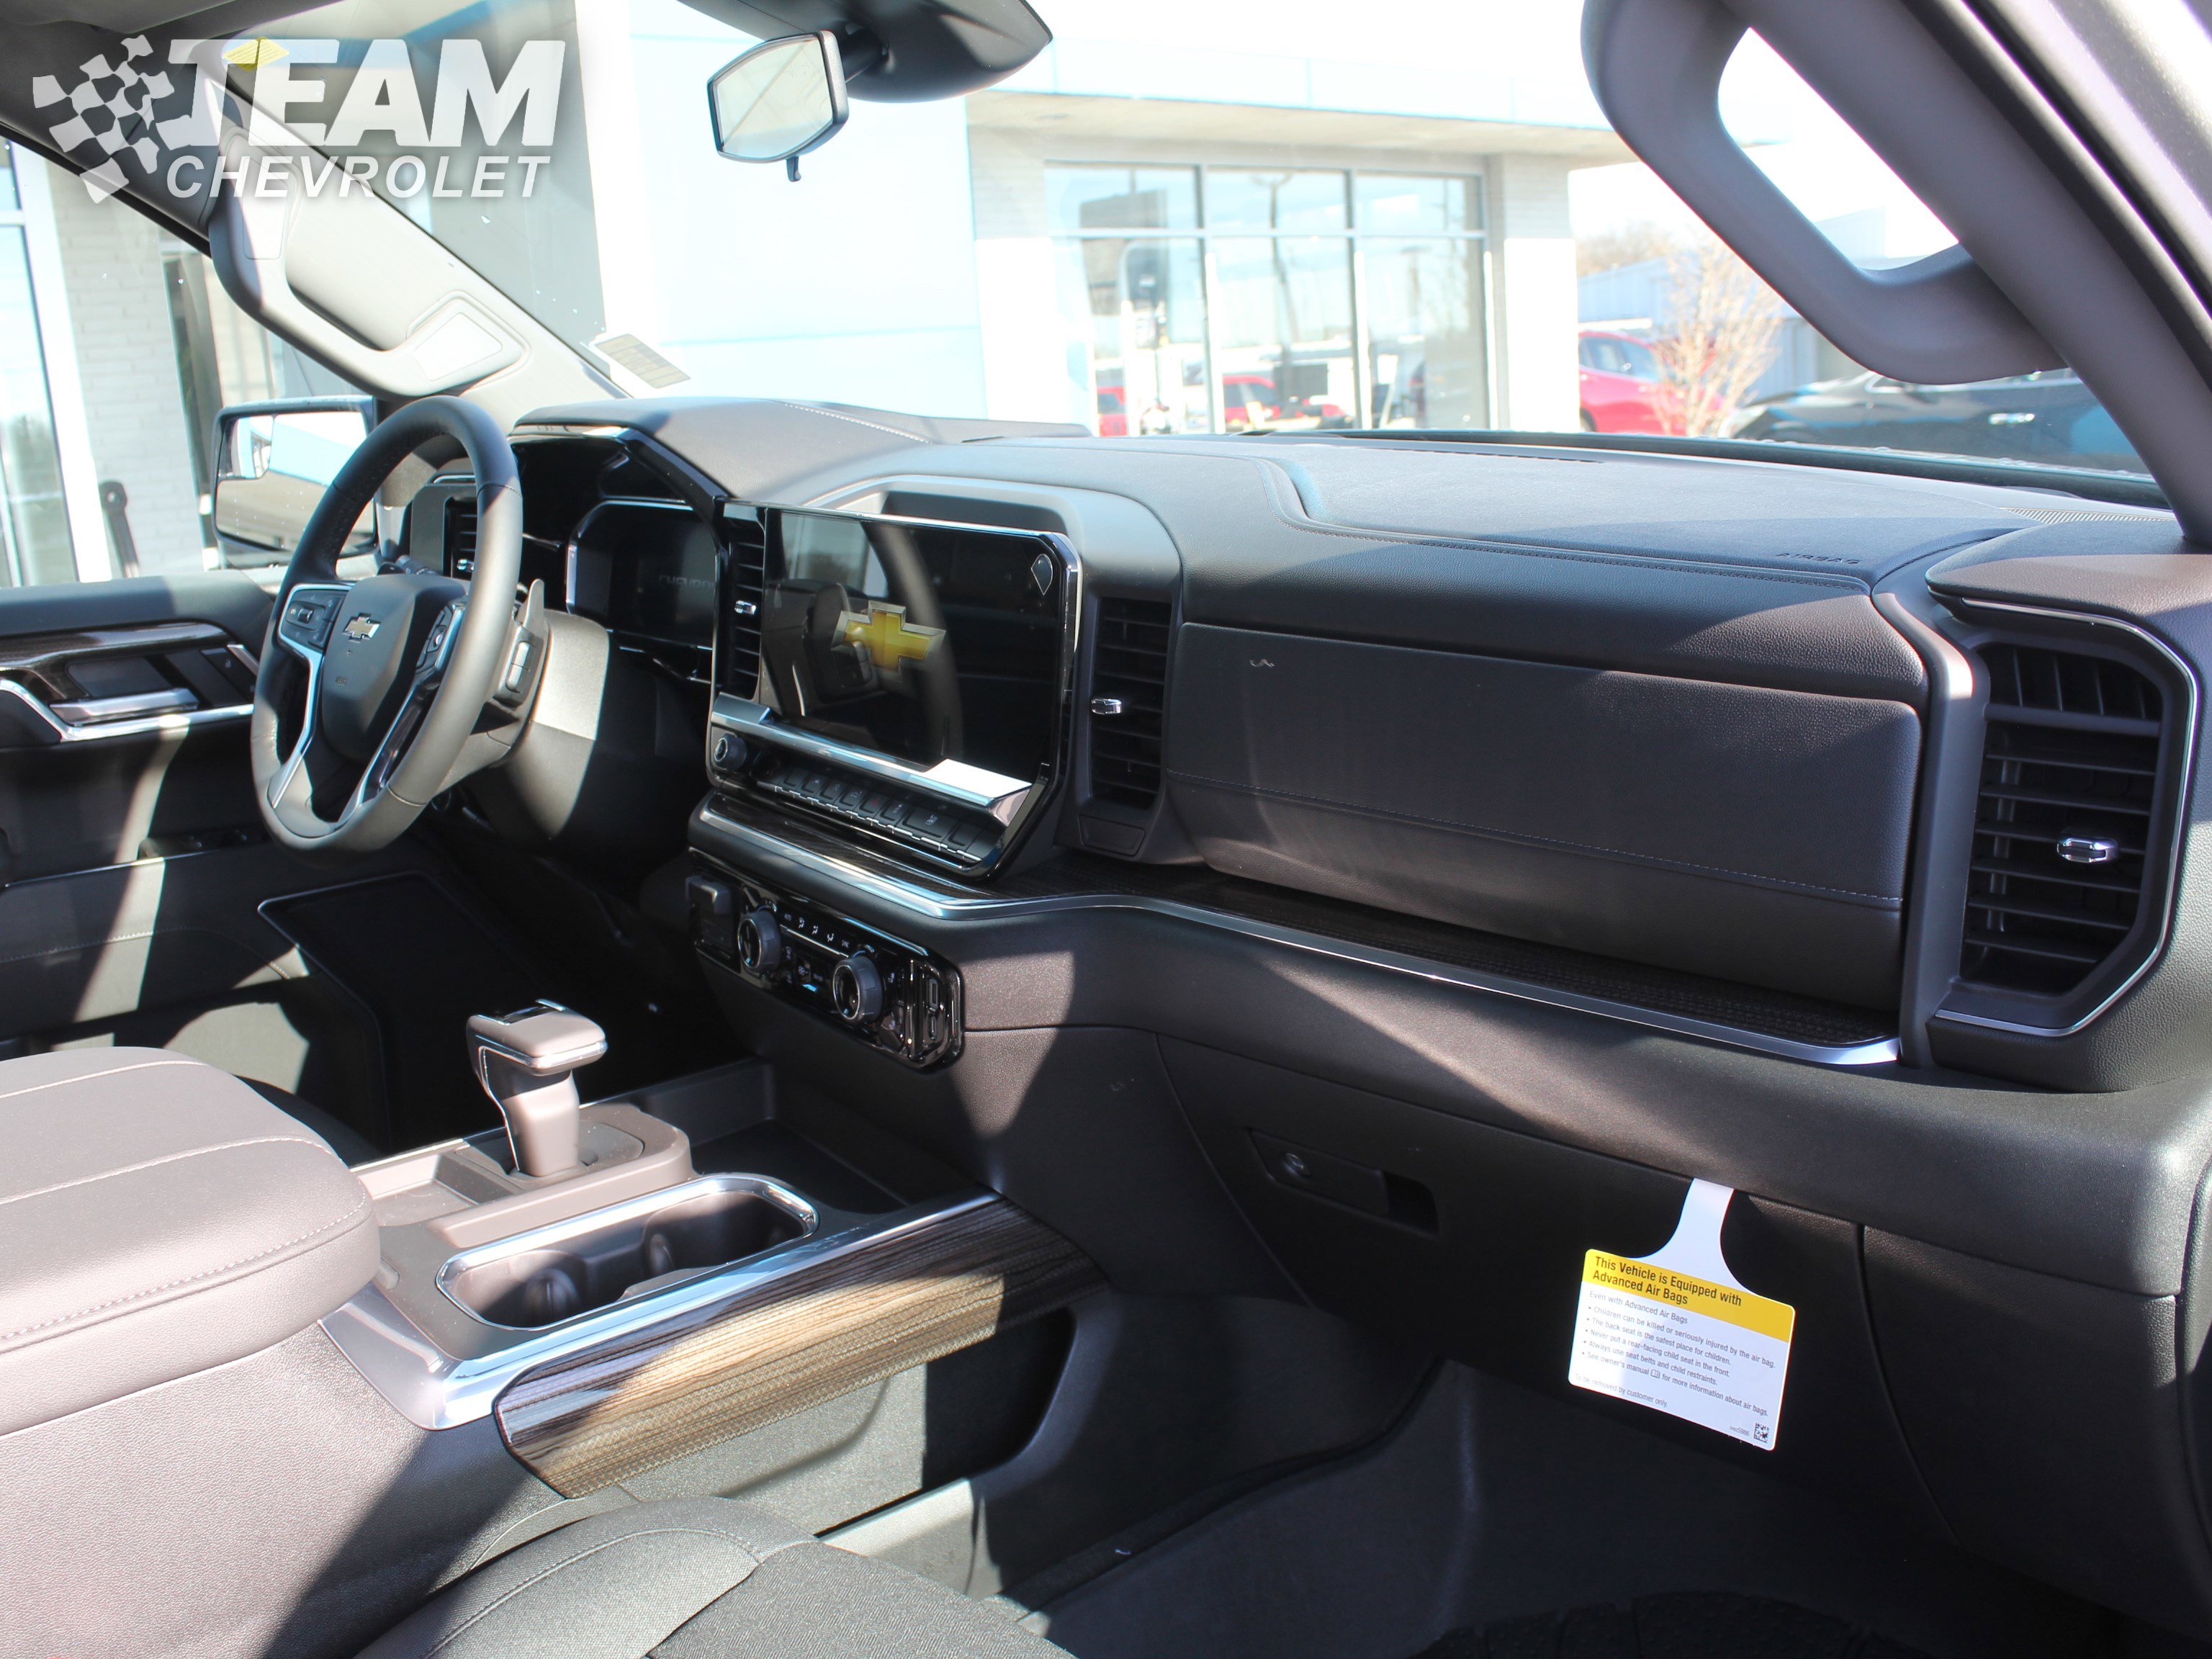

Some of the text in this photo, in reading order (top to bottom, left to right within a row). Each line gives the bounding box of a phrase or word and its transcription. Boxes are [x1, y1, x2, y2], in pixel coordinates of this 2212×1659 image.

[1593, 1269, 1688, 1305] Advanced Air Bags
[1596, 1256, 1742, 1306] This Vehicle is Equipped with
[1589, 1290, 1606, 1300] Even
[1624, 1300, 1658, 1315] Advanced
[1659, 1309, 1669, 1318] Air
[1671, 1313, 1688, 1324] Bags
[1590, 1329, 1609, 1339] Never
[1610, 1335, 1620, 1344] put
[1628, 1340, 1662, 1356] rear-facing
[1664, 1350, 1678, 1360] child
[1680, 1356, 1694, 1365] seat
[1702, 1362, 1712, 1371] the
[1714, 1365, 1730, 1377] front.
[1592, 1317, 1604, 1326] The
[1605, 1321, 1620, 1331] back
[1622, 1326, 1635, 1335] seat
[1645, 1332, 1654, 1341] the
[1655, 1336, 1675, 1347] safest
[1676, 1341, 1693, 1352] place
[1704, 1351, 1731, 1365] children.
[1593, 1306, 1621, 1319] Children
[1647, 1321, 1664, 1331] killed
[1674, 1330, 1704, 1345] seriously
[1705, 1338, 1728, 1352] injured
[1730, 1346, 1737, 1356] by
[1740, 1350, 1750, 1359] the
[1762, 1357, 1775, 1369] bag.
[1588, 1341, 1611, 1352] Always
[1625, 1352, 1639, 1360] seat
[1641, 1354, 1656, 1365] belts
[1658, 1360, 1669, 1370] and
[1671, 1364, 1685, 1375] child
[1687, 1370, 1718, 1385] restraints.
[1588, 1352, 1599, 1360] See
[1627, 1363, 1649, 1375] manual
[1672, 1377, 1688, 1388] more
[1689, 1382, 1724, 1400] information
[1725, 1395, 1742, 1407] about
[1753, 1405, 1769, 1416] bags.
[1618, 1386, 1626, 1395] by
[1627, 1390, 1654, 1403] customer
